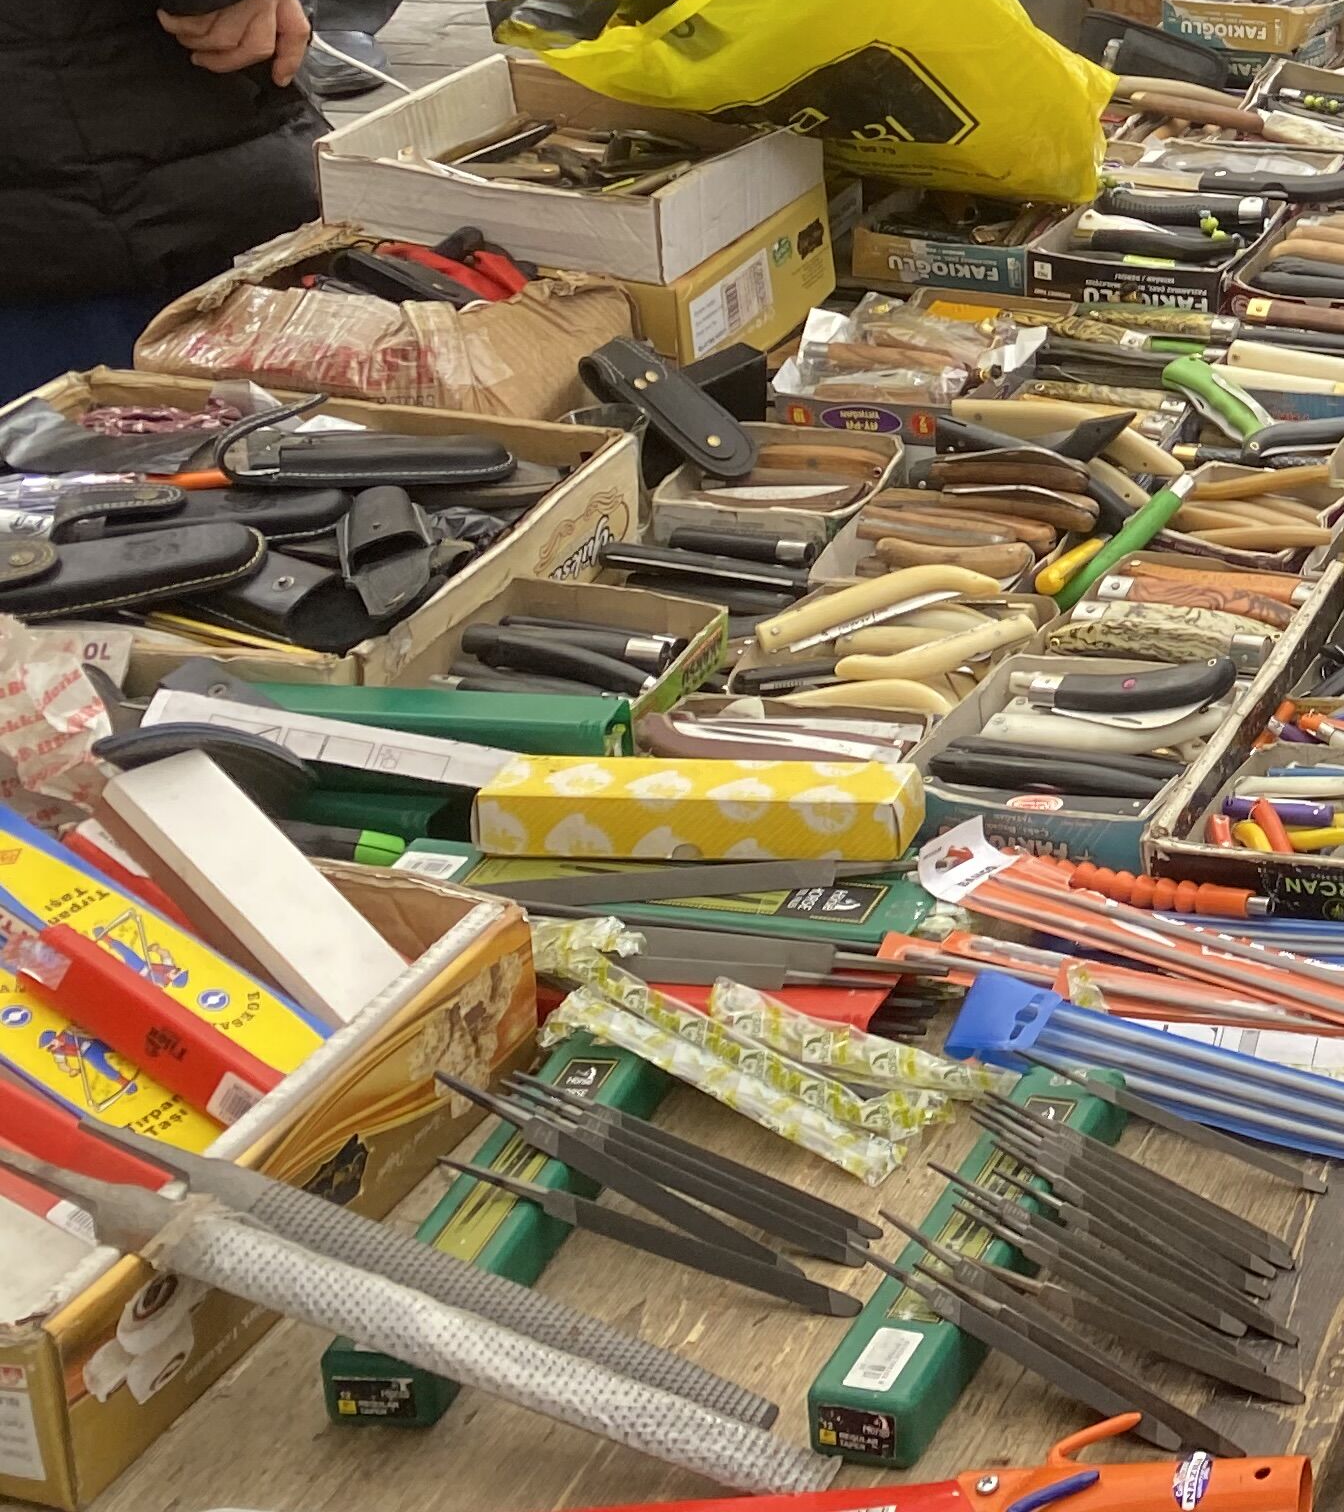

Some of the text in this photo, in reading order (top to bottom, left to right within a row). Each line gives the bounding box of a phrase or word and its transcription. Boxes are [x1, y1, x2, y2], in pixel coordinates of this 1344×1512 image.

[1181, 21, 1267, 41] FAKIOĞLU
[887, 255, 999, 282] FAKIOĞLU
[1083, 287, 1208, 313] FAKIOLU
[83, 642, 111, 661] OL
[212, 991, 260, 1032] EGESA
[144, 1108, 189, 1138] Taşı
